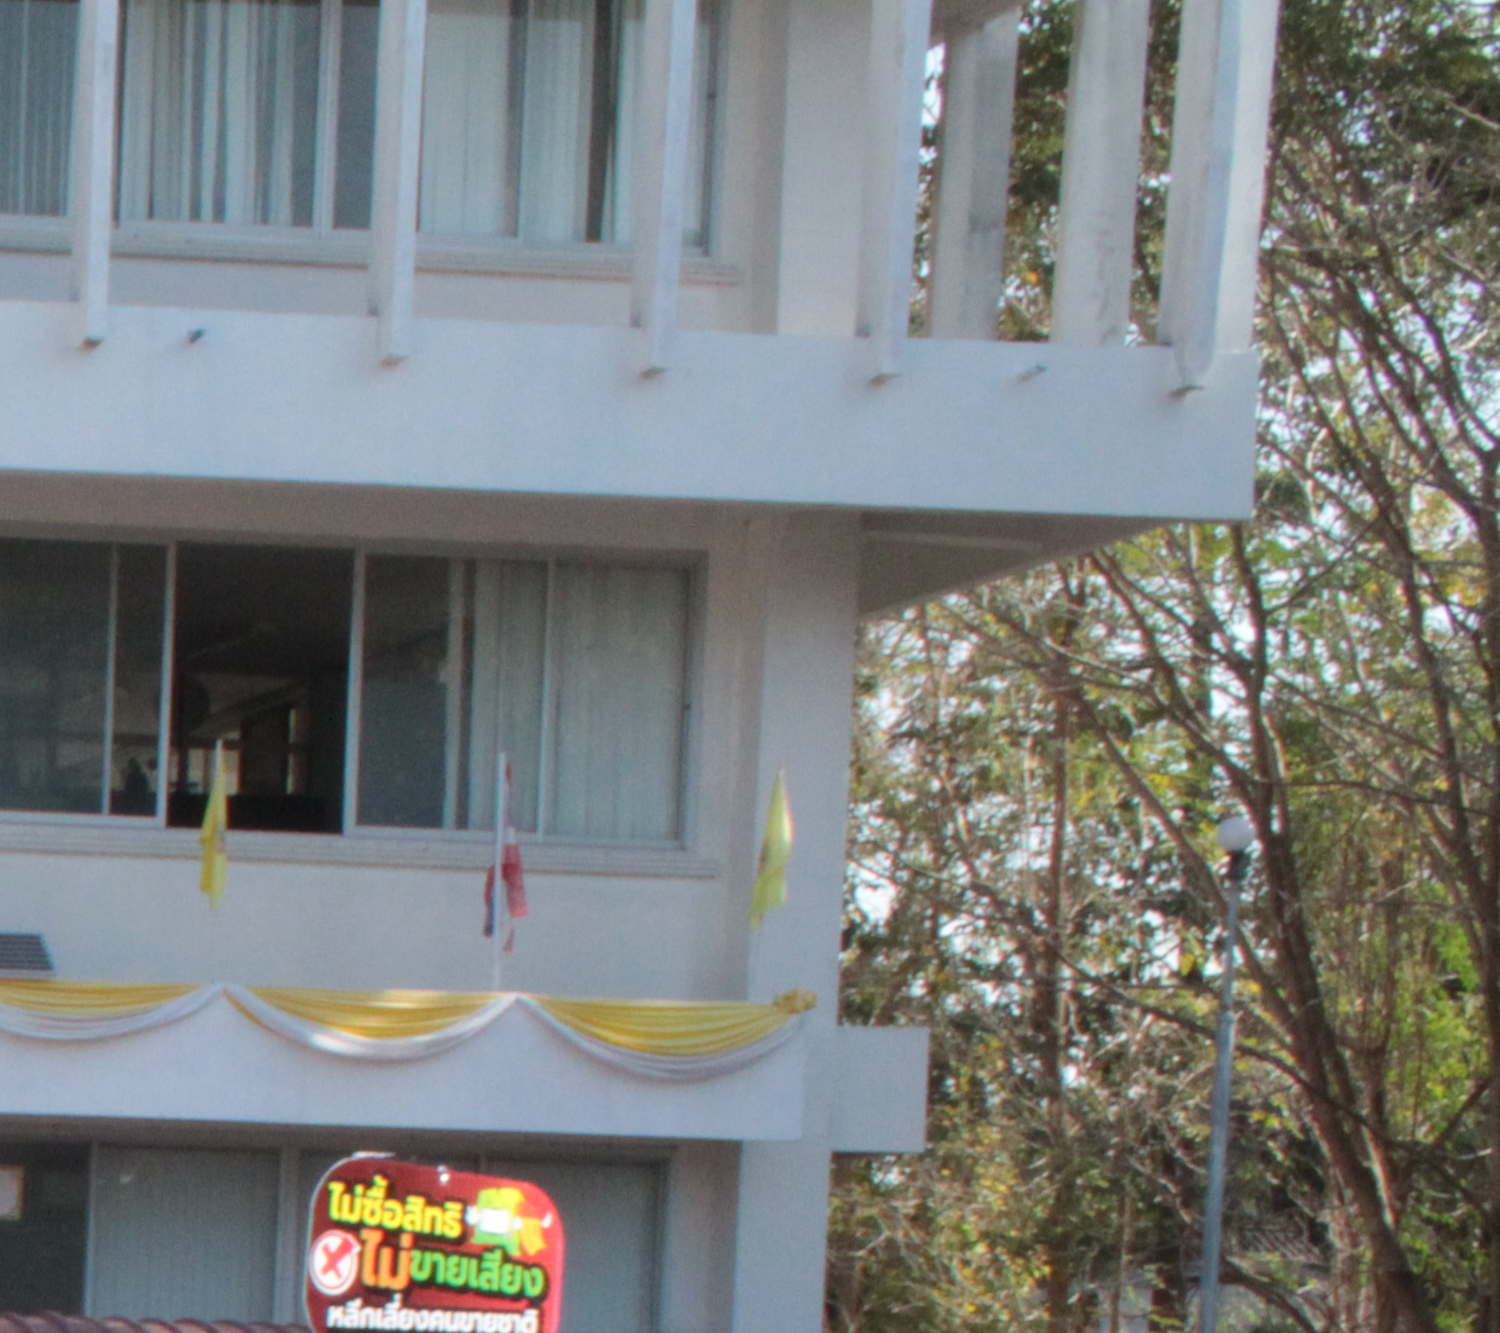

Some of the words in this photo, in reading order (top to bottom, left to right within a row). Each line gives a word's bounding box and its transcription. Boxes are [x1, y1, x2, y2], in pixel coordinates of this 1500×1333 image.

[361, 1229, 545, 1298] ไม่ขายเสียง
